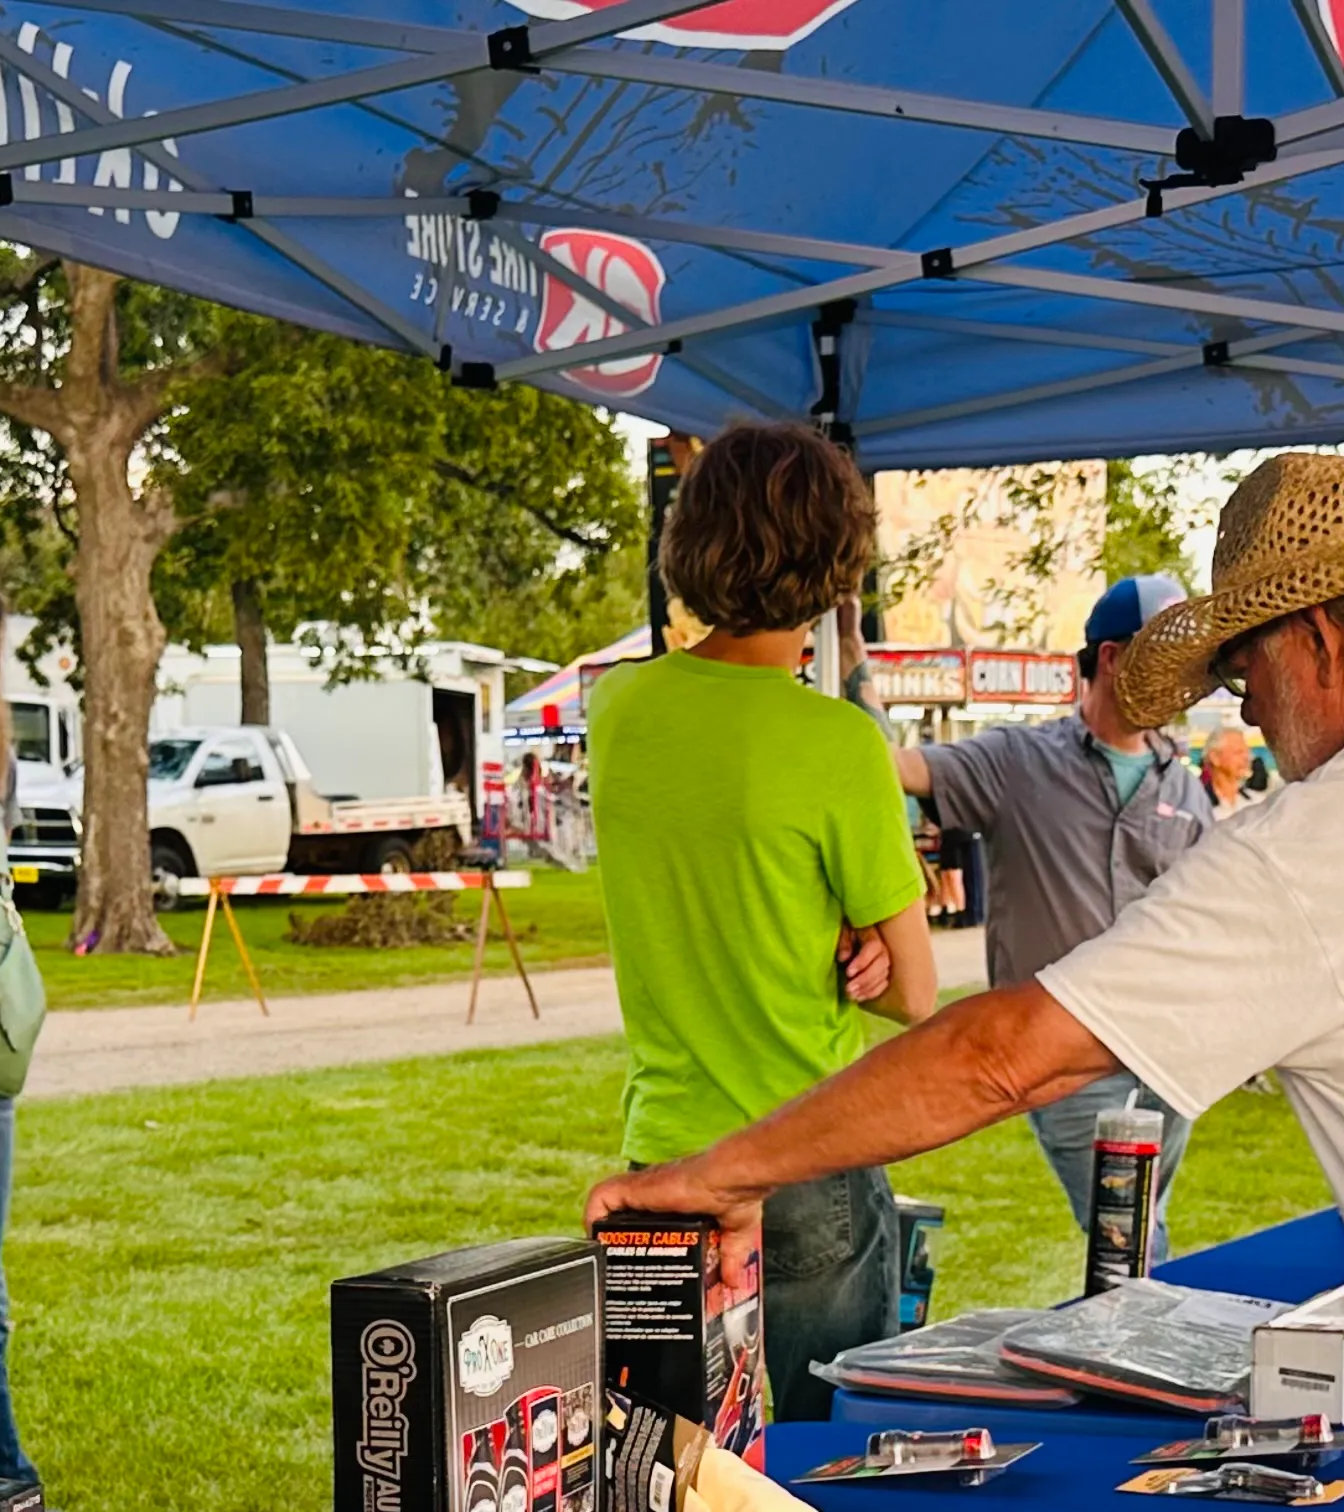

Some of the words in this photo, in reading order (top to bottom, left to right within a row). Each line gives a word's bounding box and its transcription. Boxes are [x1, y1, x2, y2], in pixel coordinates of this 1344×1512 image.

[870, 670, 965, 699] RINKS
[651, 1231, 700, 1246] CABLES
[364, 1323, 412, 1472] O'Reilly
